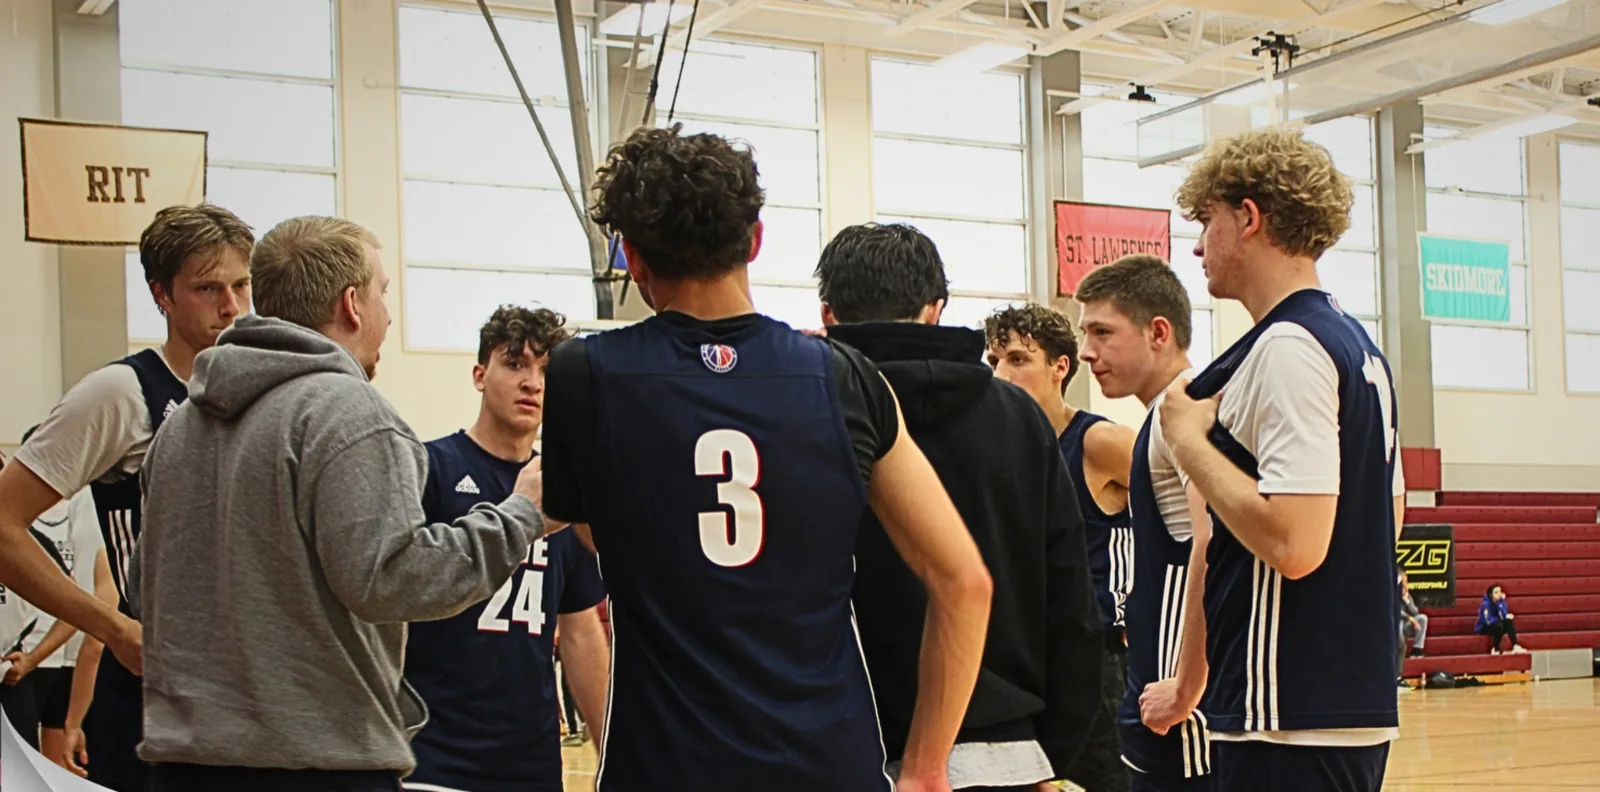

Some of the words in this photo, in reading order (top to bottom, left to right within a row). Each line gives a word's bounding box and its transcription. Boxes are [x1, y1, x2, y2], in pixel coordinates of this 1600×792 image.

[85, 164, 150, 203] RIT
[1066, 234, 1087, 264] ST.
[1426, 262, 1506, 297] SKIDMORE
[694, 428, 765, 567] 3
[477, 569, 546, 636] 24
